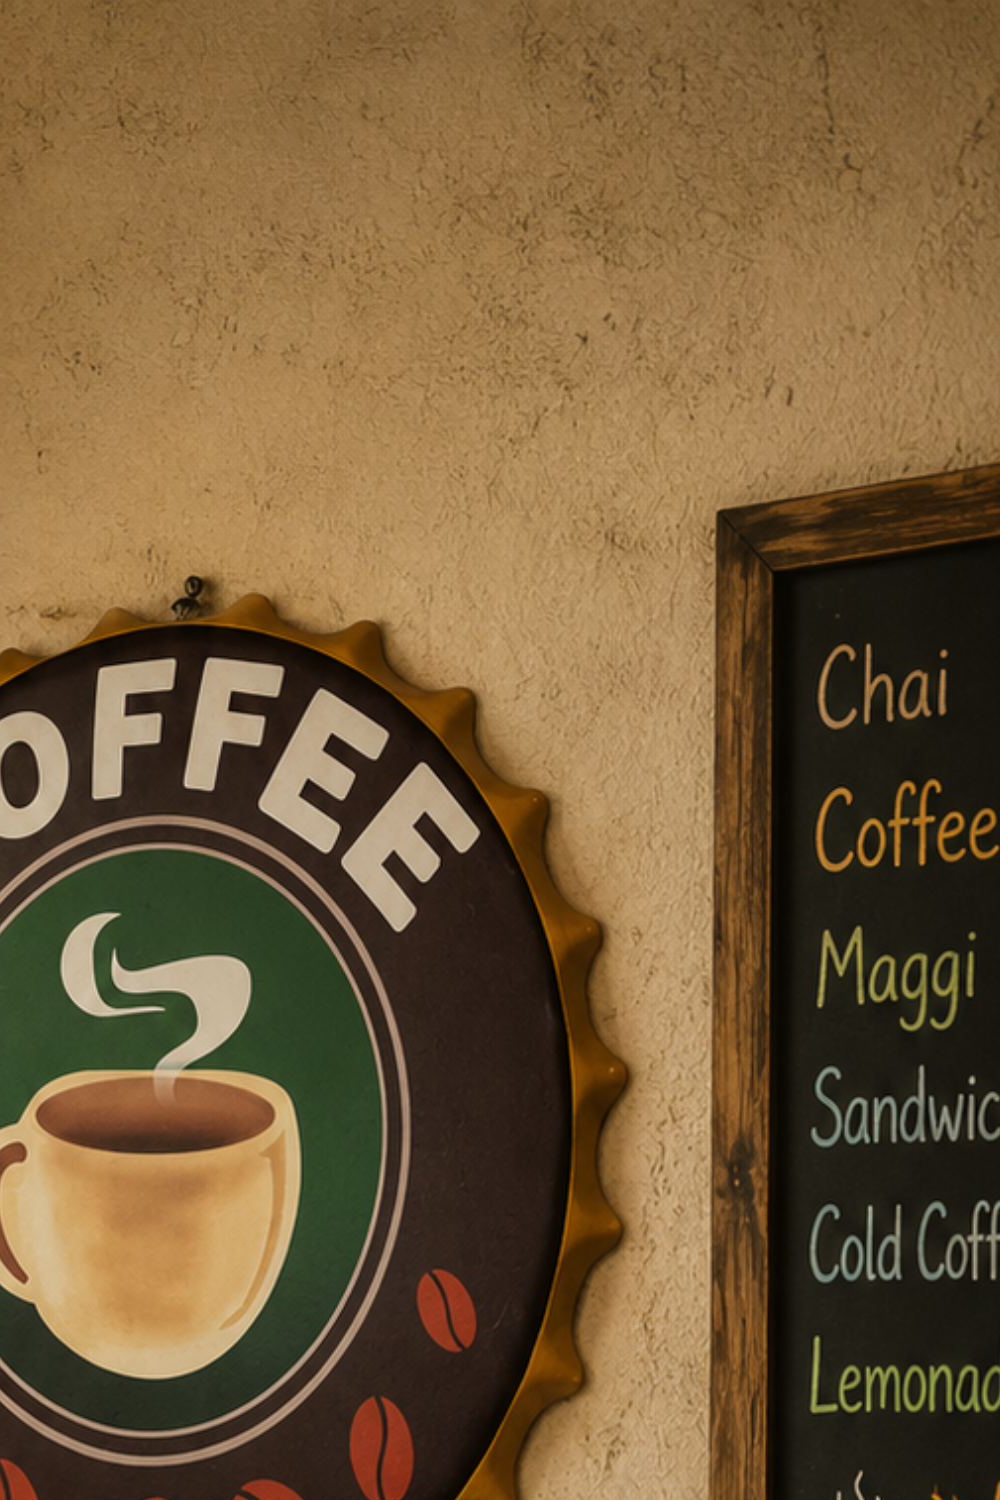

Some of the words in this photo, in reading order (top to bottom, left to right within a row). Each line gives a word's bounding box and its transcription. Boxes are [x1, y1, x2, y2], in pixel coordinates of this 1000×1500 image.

[817, 643, 948, 730] Chai
[815, 778, 1000, 873] Coffee
[816, 925, 977, 1032] Maggi
[810, 1064, 1000, 1148] Sandwic
[809, 1204, 902, 1283] Cold
[917, 1199, 1000, 1282] Coff
